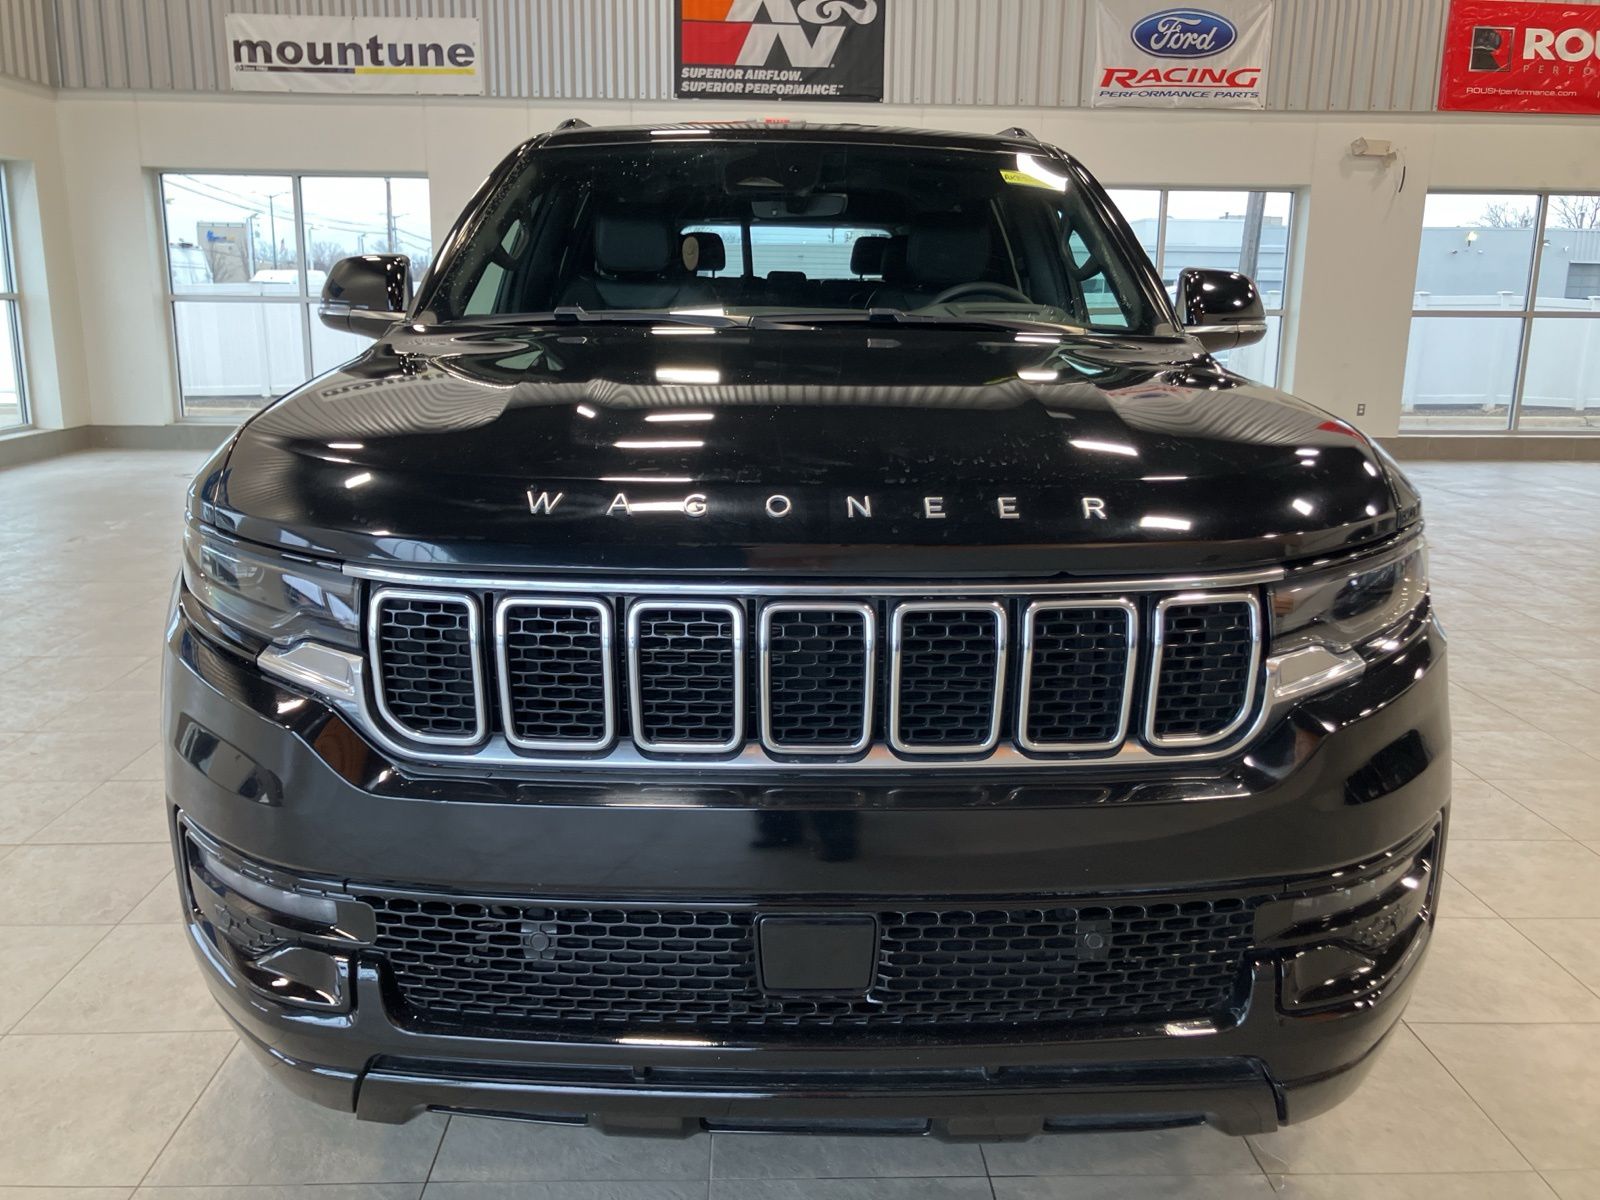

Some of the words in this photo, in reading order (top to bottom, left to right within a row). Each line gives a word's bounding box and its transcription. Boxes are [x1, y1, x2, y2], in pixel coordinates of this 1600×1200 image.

[1150, 17, 1218, 50] Ford
[232, 35, 476, 67] mountune
[1523, 27, 1600, 62] RO
[681, 68, 744, 80] SUPERIOR
[745, 70, 803, 82] AIRFLOW.
[1100, 68, 1262, 89] RACING
[681, 81, 743, 93] SUPERIOR
[1099, 90, 1209, 98] PERFORMANCE
[1213, 91, 1260, 99] PARTS
[1466, 87, 1577, 97] ROUSHperformance.com
[526, 490, 1108, 520] WAGONEER
